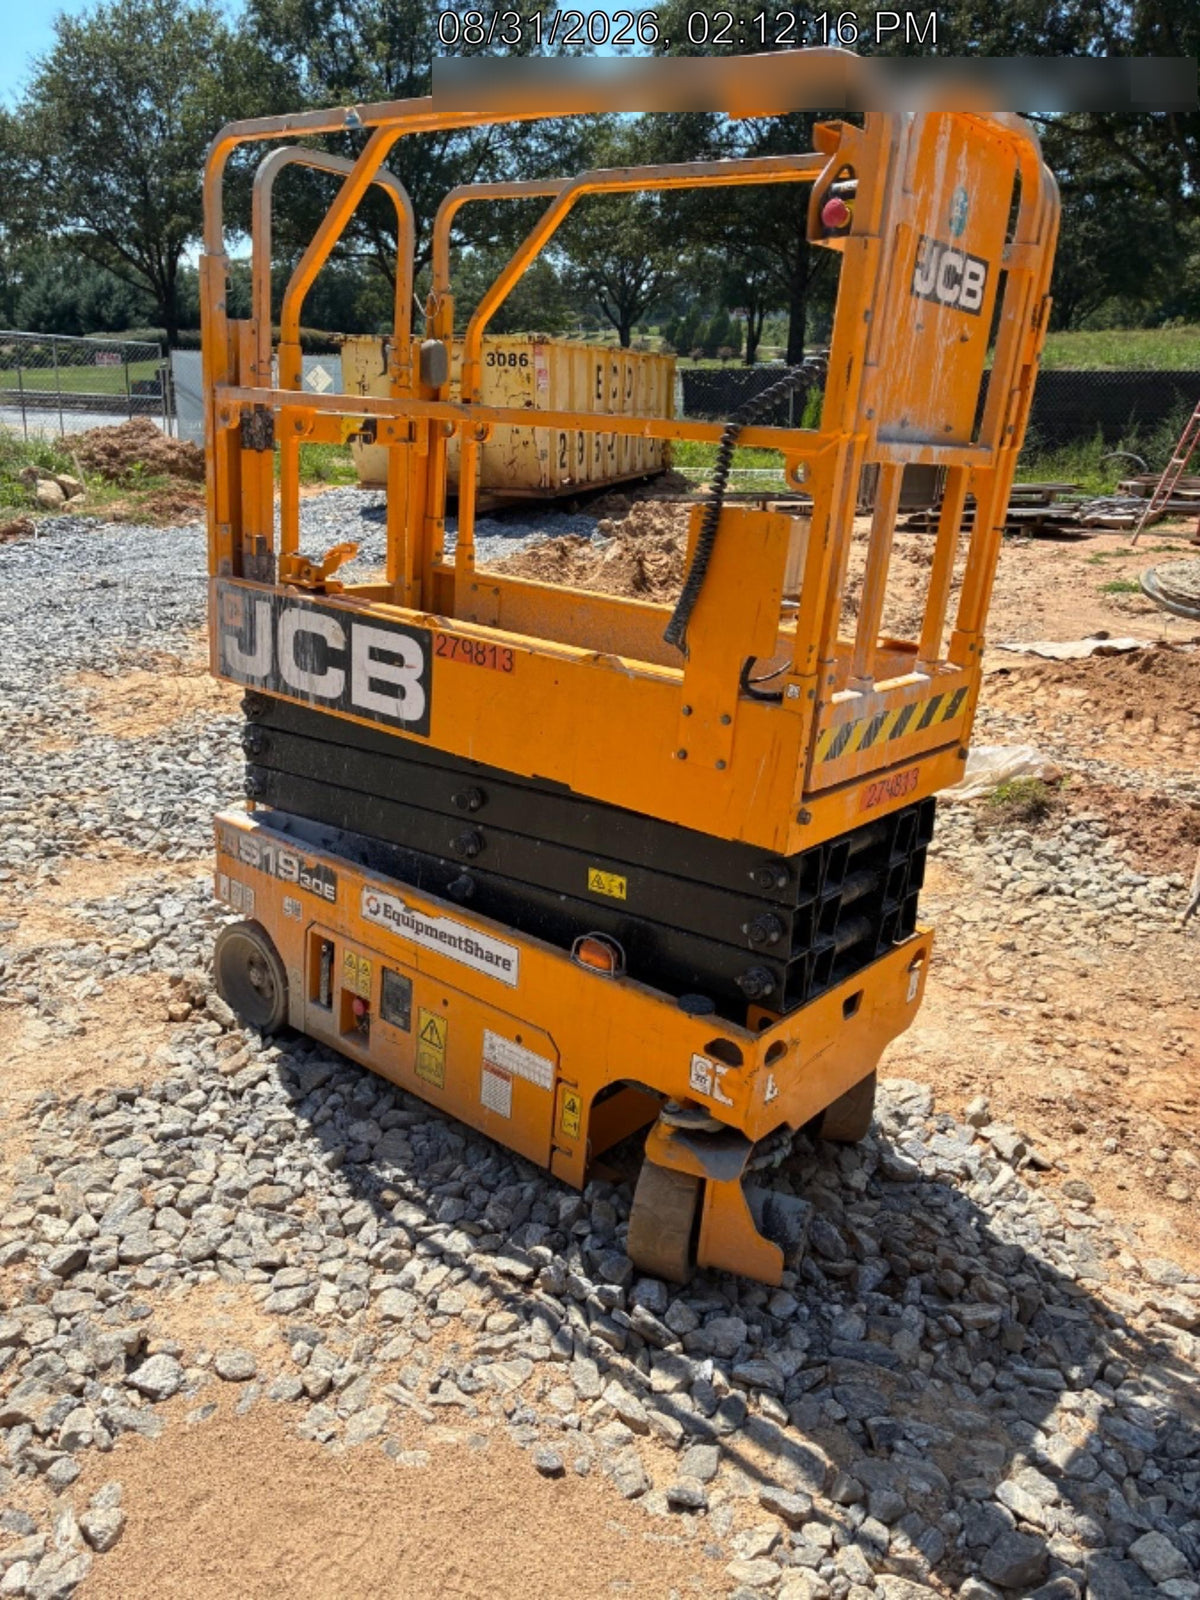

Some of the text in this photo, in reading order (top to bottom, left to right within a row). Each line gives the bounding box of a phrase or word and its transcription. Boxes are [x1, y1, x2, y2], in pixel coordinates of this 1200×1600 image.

[914, 240, 986, 311] JCB
[486, 352, 529, 367] 3086
[225, 600, 426, 722] JCB
[435, 633, 514, 673] 279813
[382, 901, 512, 972] EquipmentShare
